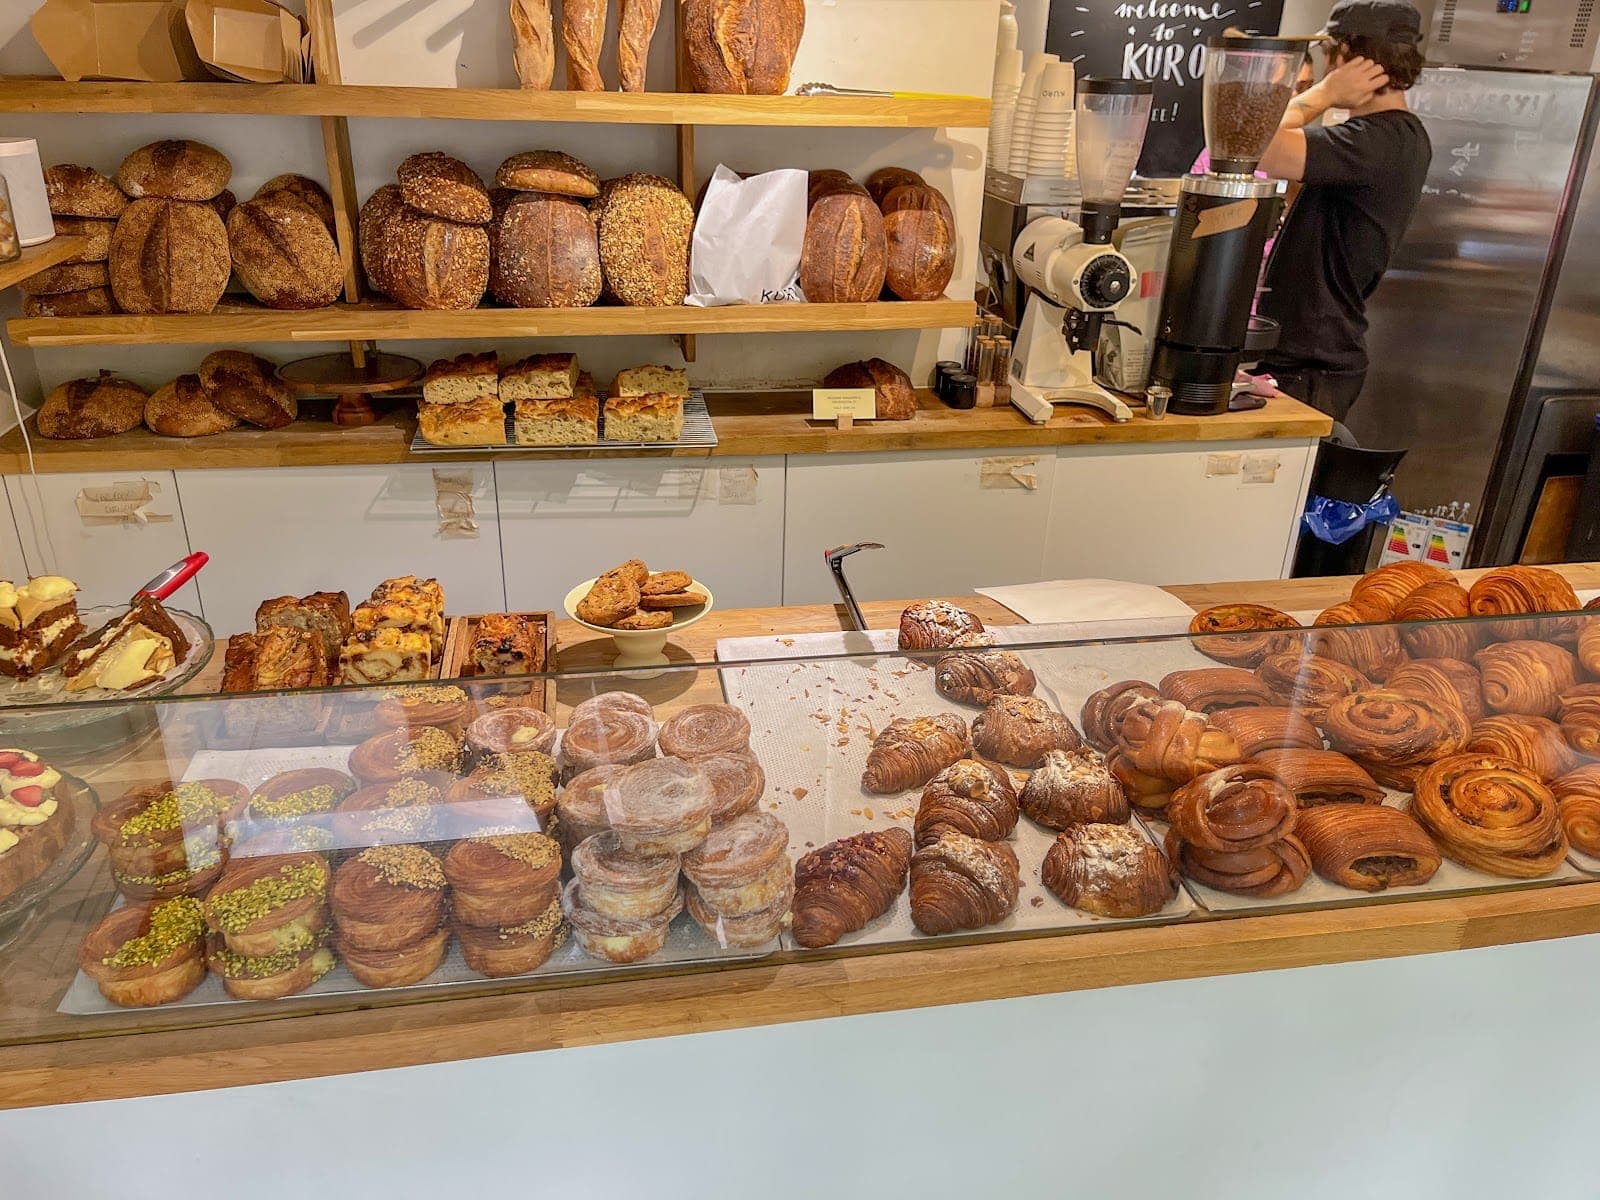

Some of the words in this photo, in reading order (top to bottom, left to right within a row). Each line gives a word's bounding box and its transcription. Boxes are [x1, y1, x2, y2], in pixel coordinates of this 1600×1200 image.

[1114, 0, 1236, 20] welcome
[1150, 22, 1187, 41] to
[1122, 42, 1206, 86] KURO
